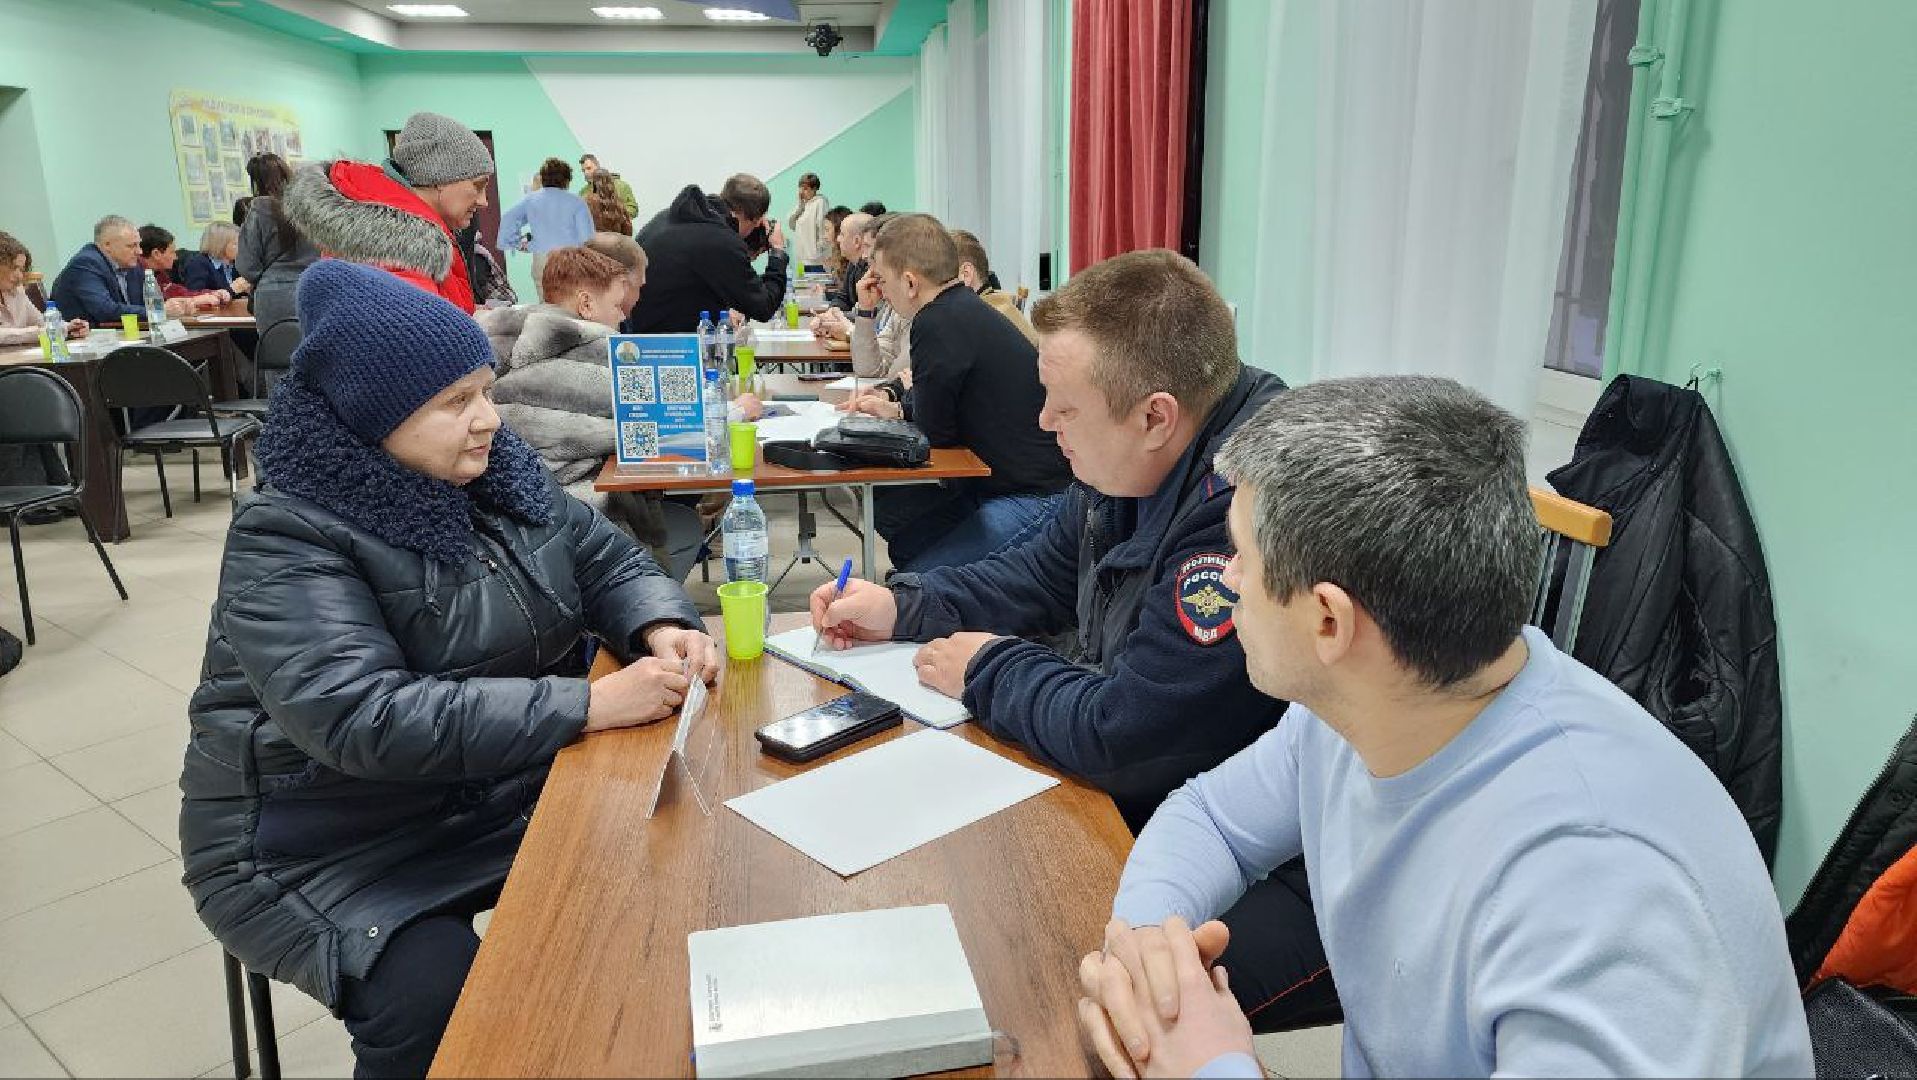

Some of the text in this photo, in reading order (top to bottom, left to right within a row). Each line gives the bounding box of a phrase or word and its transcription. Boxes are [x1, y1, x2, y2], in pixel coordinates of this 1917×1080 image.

[1183, 556, 1231, 574] ПОЛИЦ
[1183, 571, 1224, 590] РОСС
[1194, 625, 1218, 641] МВД
